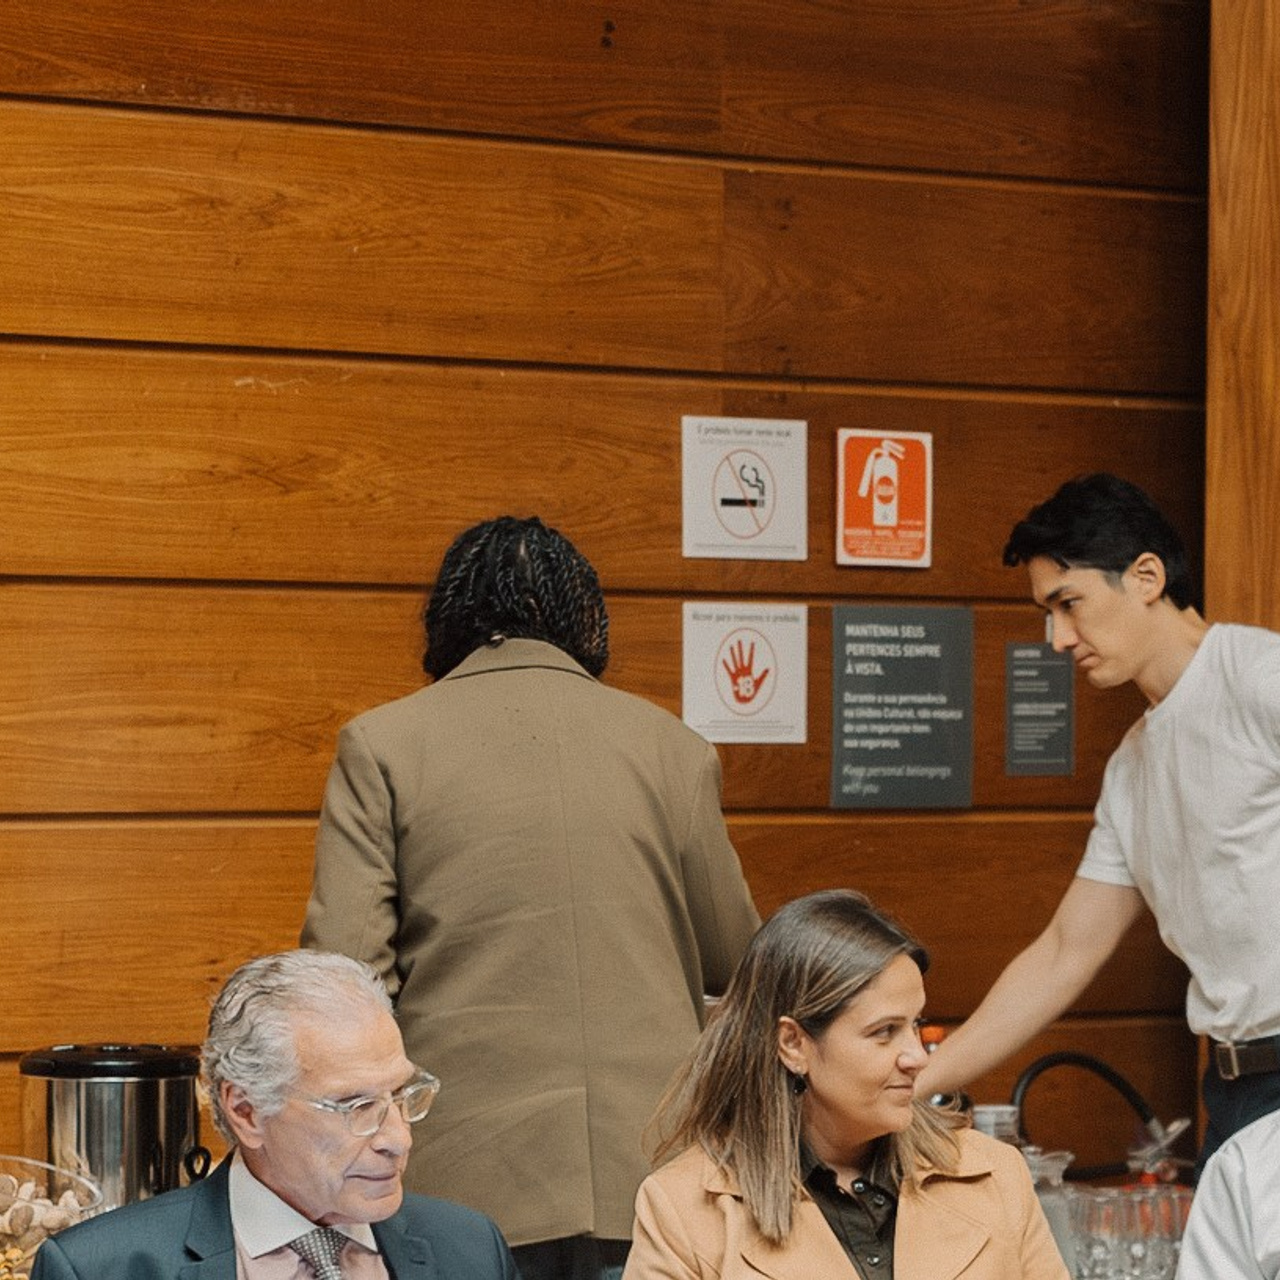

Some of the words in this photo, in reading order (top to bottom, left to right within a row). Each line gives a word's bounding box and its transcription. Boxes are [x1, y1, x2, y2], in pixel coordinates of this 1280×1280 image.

[845, 624, 899, 637] MANTENHA
[901, 625, 926, 638] SEUS
[845, 643, 902, 657] PERTENCES
[902, 643, 941, 657] SEMPRE
